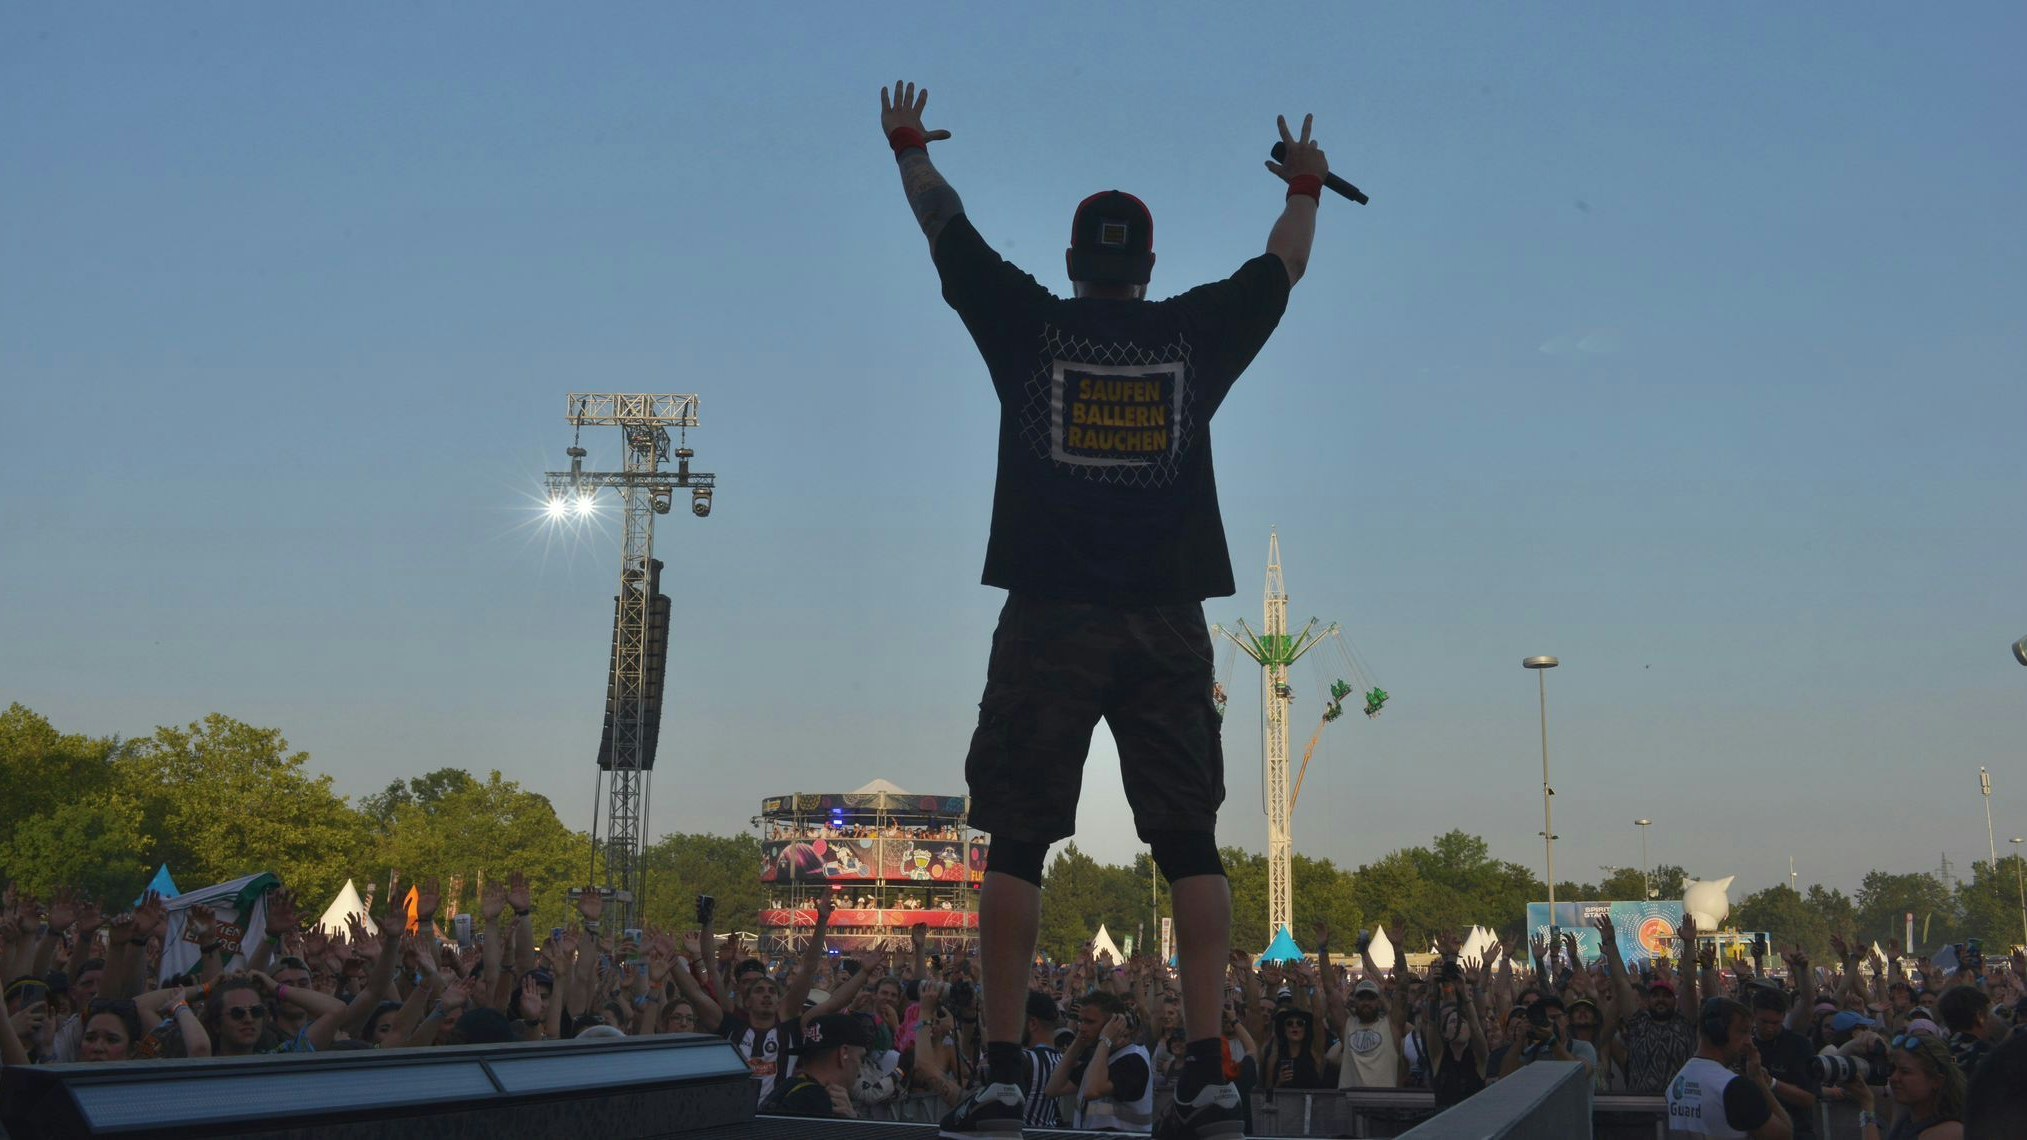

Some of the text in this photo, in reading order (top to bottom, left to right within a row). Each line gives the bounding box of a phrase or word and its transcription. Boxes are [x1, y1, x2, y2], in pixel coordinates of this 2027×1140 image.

[1079, 379, 1161, 401] SAUFEN
[1072, 402, 1166, 427] BALLERN
[1068, 426, 1168, 451] RAUCHEN
[1670, 1102, 1701, 1119] Guard
